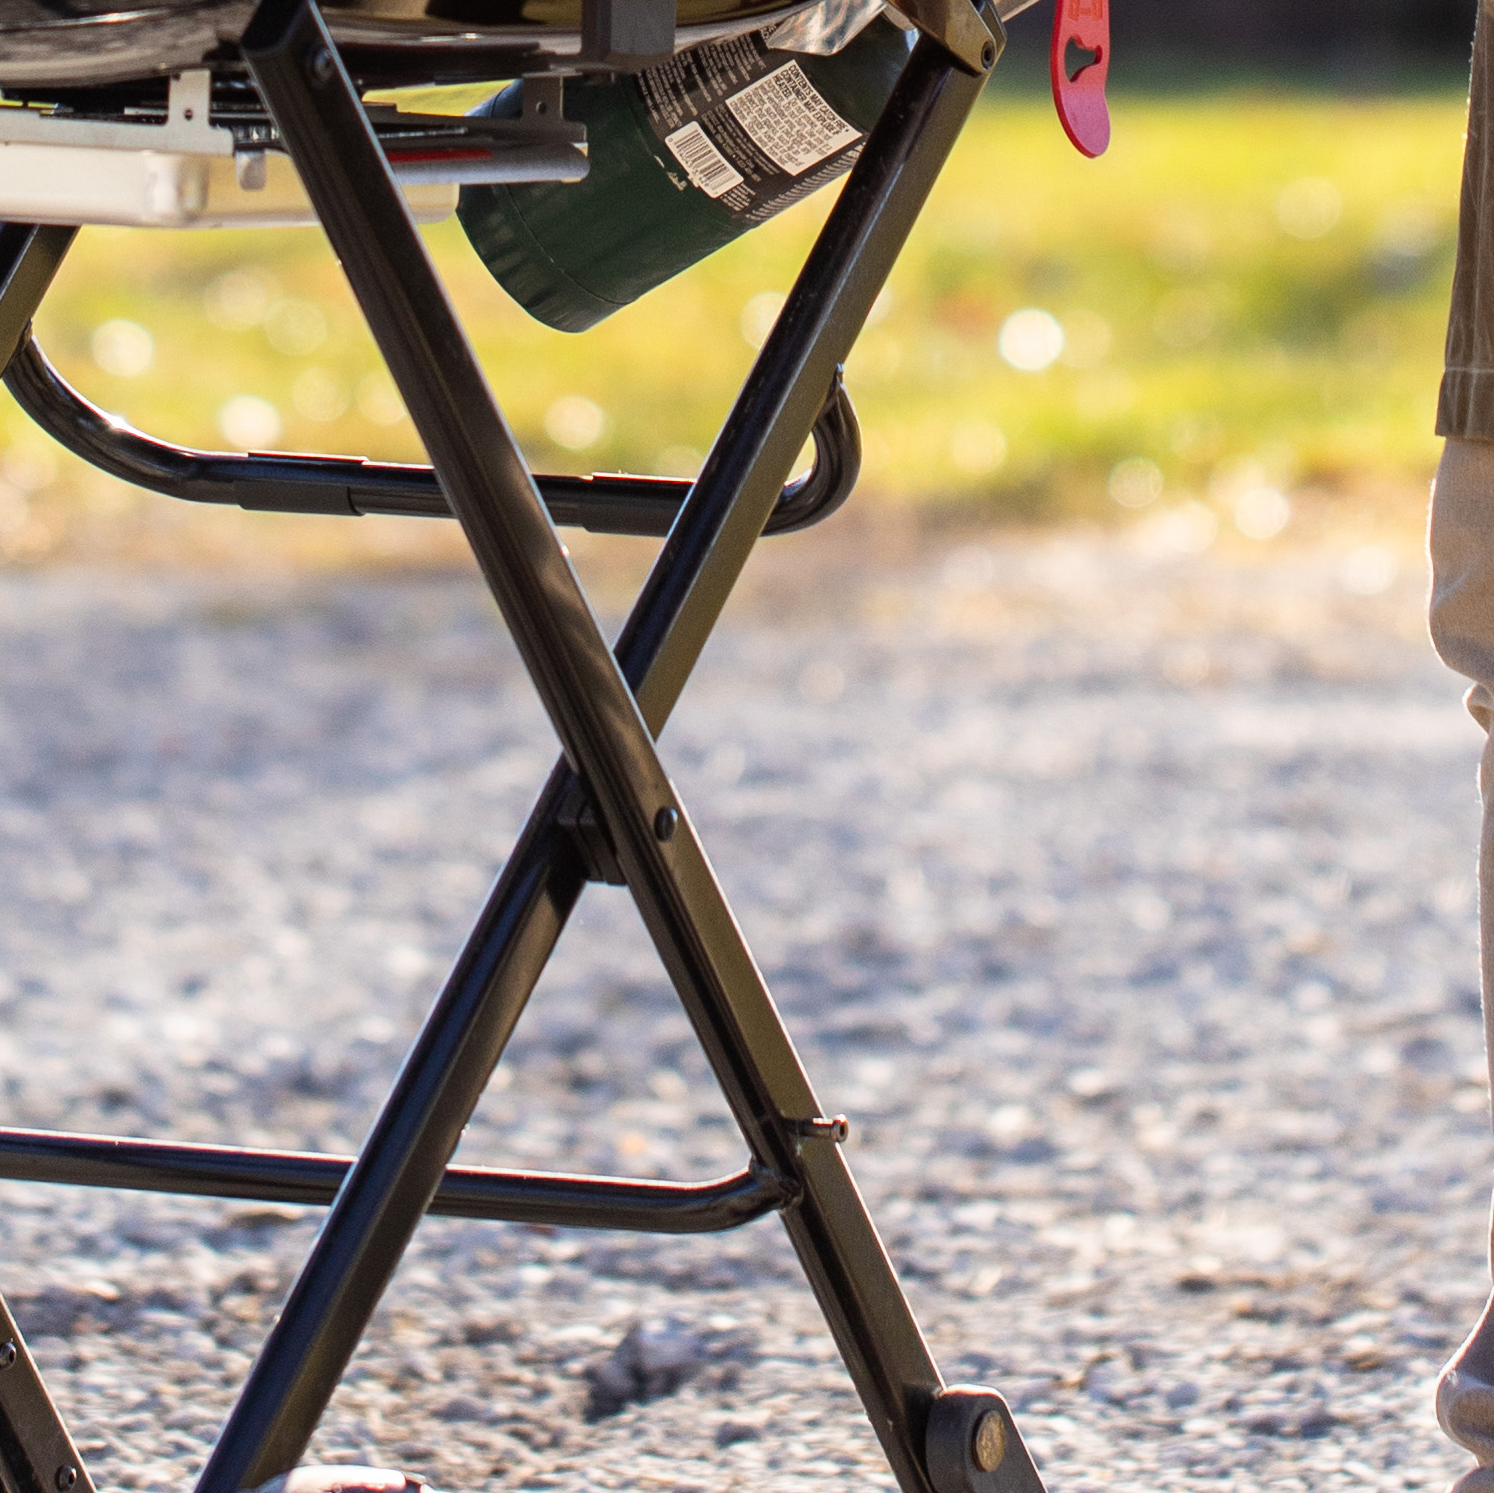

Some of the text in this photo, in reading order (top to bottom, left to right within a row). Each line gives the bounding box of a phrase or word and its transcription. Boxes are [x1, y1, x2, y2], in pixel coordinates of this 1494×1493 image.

[779, 68, 807, 103] CONTAINER
[802, 99, 817, 114] MAY
[811, 110, 836, 132] EXPLODE
[808, 93, 823, 107] MAY
[818, 104, 838, 122] CATCH
